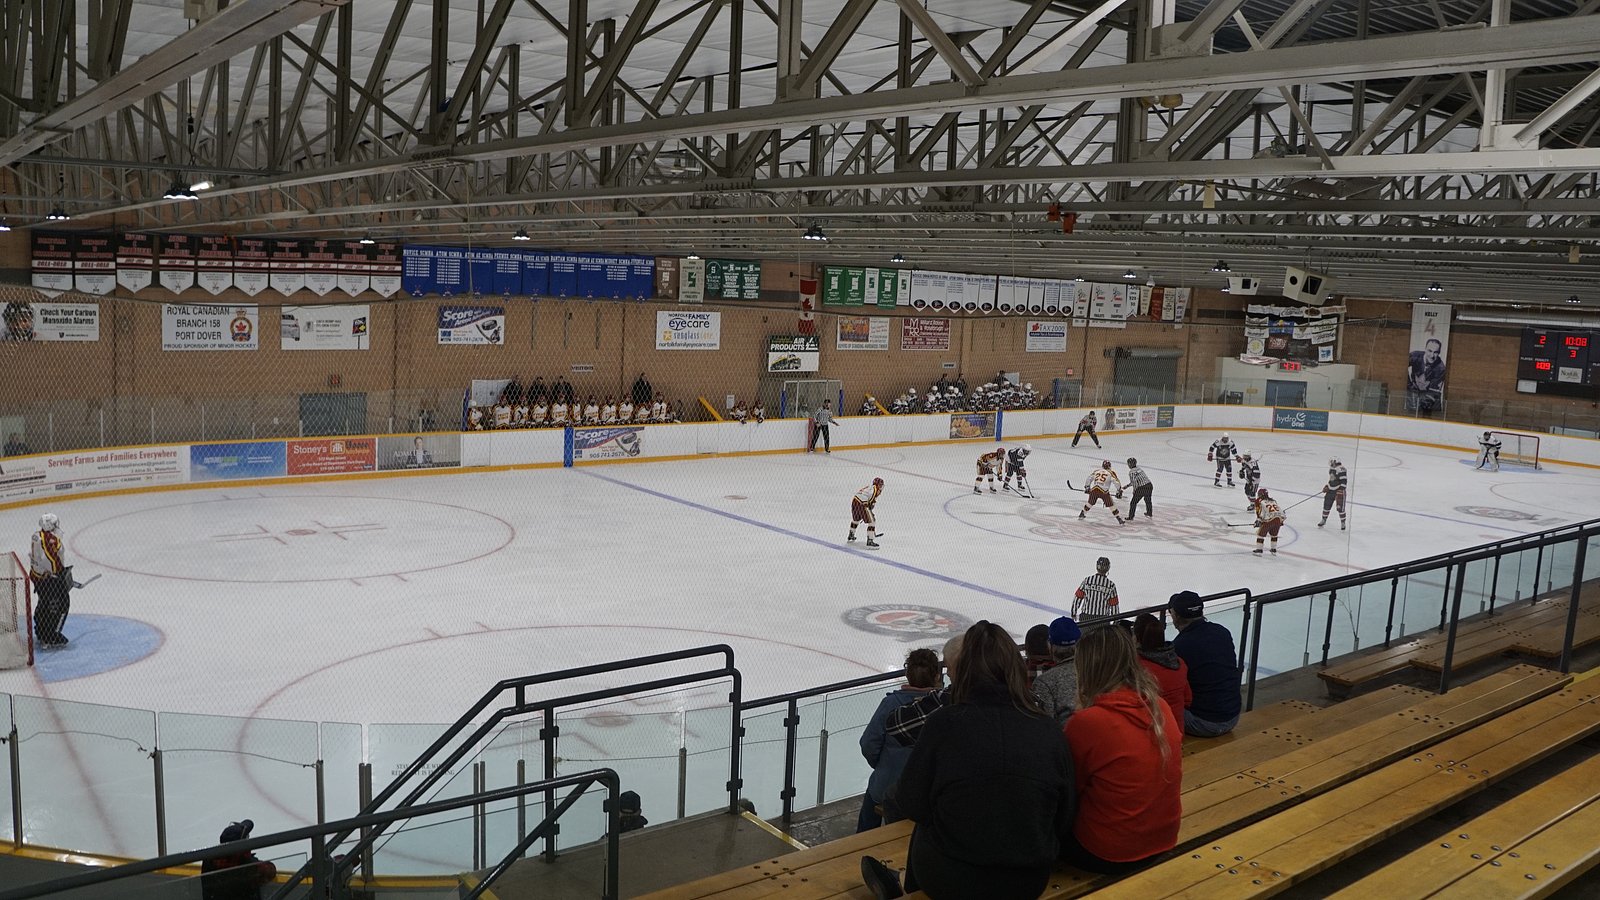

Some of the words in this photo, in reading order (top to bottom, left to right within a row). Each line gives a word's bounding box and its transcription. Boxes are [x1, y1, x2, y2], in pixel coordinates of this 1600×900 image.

[167, 307, 190, 315] ROYAL
[193, 307, 229, 315] CANADIAN
[444, 310, 473, 321] Score
[177, 319, 207, 327] BRANCH
[210, 319, 220, 327] 158
[669, 320, 710, 331] eyecare
[1424, 318, 1435, 336] 4
[176, 332, 194, 340] PORT
[197, 332, 221, 340] DOVER
[1539, 335, 1546, 345] 2
[1569, 350, 1577, 358] 3
[1277, 414, 1297, 424] hydro
[575, 430, 608, 440] Score
[293, 444, 327, 455] Stoney's
[48, 458, 73, 468] Serving
[74, 456, 94, 465] Farms
[97, 454, 108, 462] and
[110, 452, 137, 461] Families
[139, 450, 177, 461] Everywhere
[1094, 473, 1108, 482] 25
